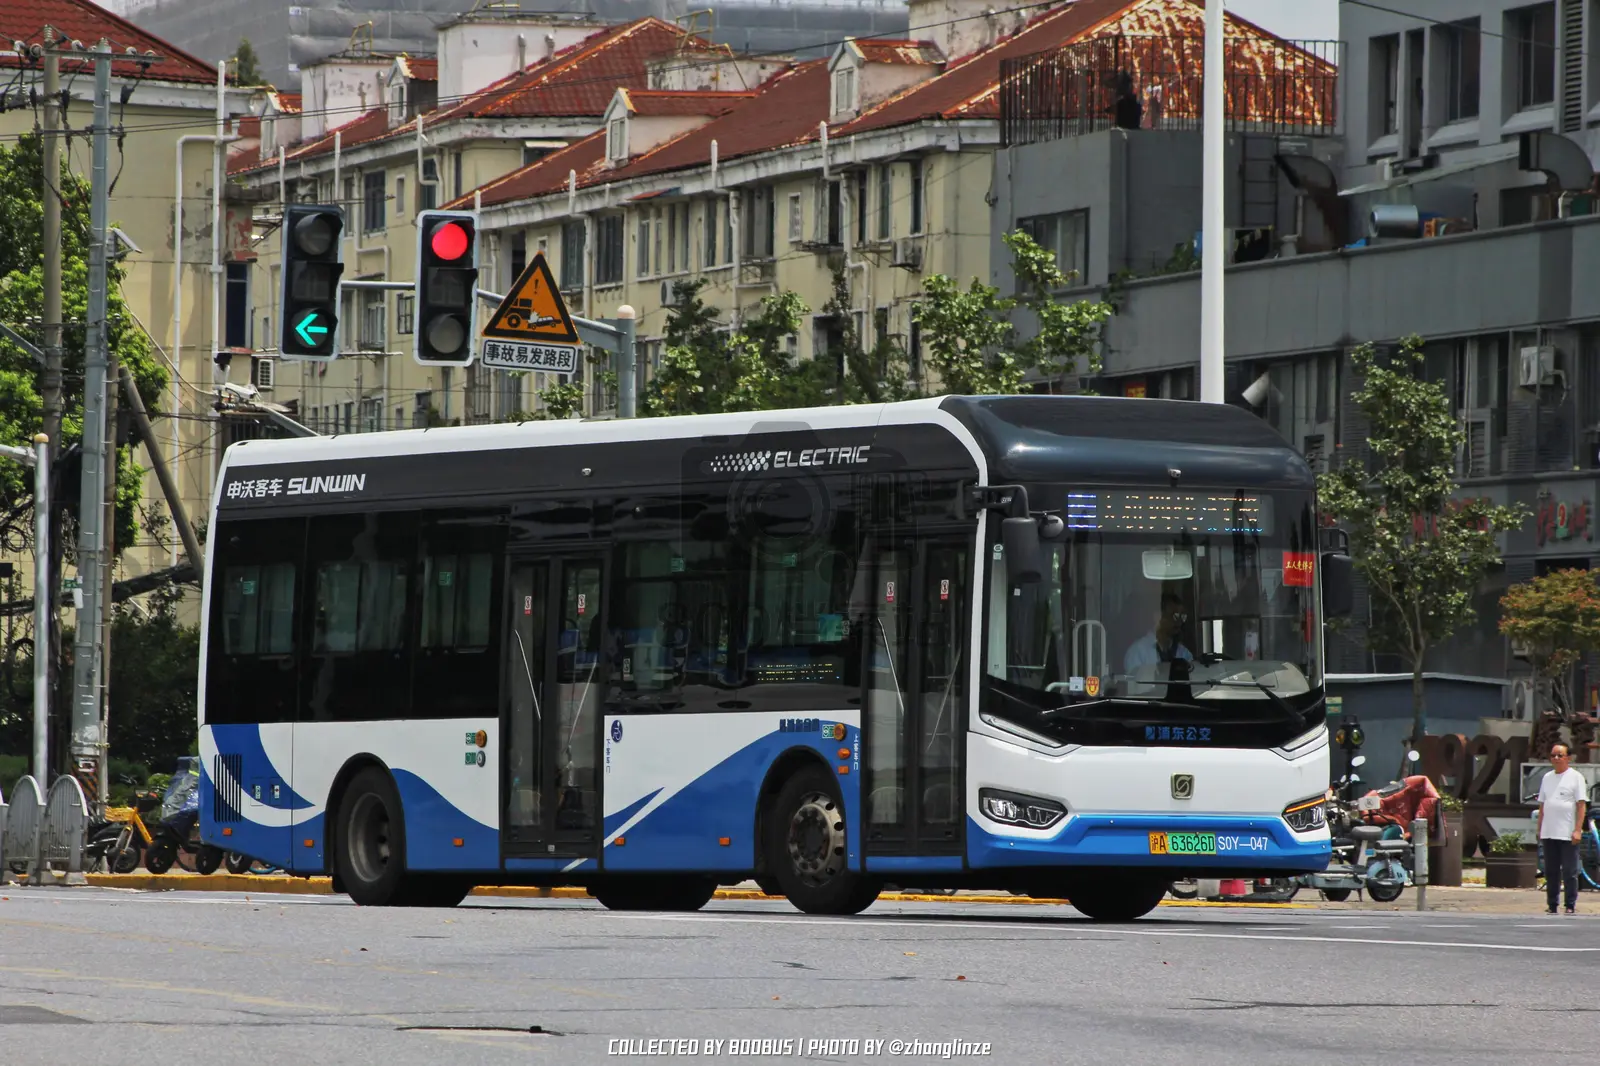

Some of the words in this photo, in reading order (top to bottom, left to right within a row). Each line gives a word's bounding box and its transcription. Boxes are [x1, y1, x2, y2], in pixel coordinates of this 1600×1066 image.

[485, 342, 572, 368] 事故易发路段
[773, 445, 871, 469] ELECTRIC
[226, 477, 282, 500] 申沃客车
[286, 473, 366, 496] SUNWIN
